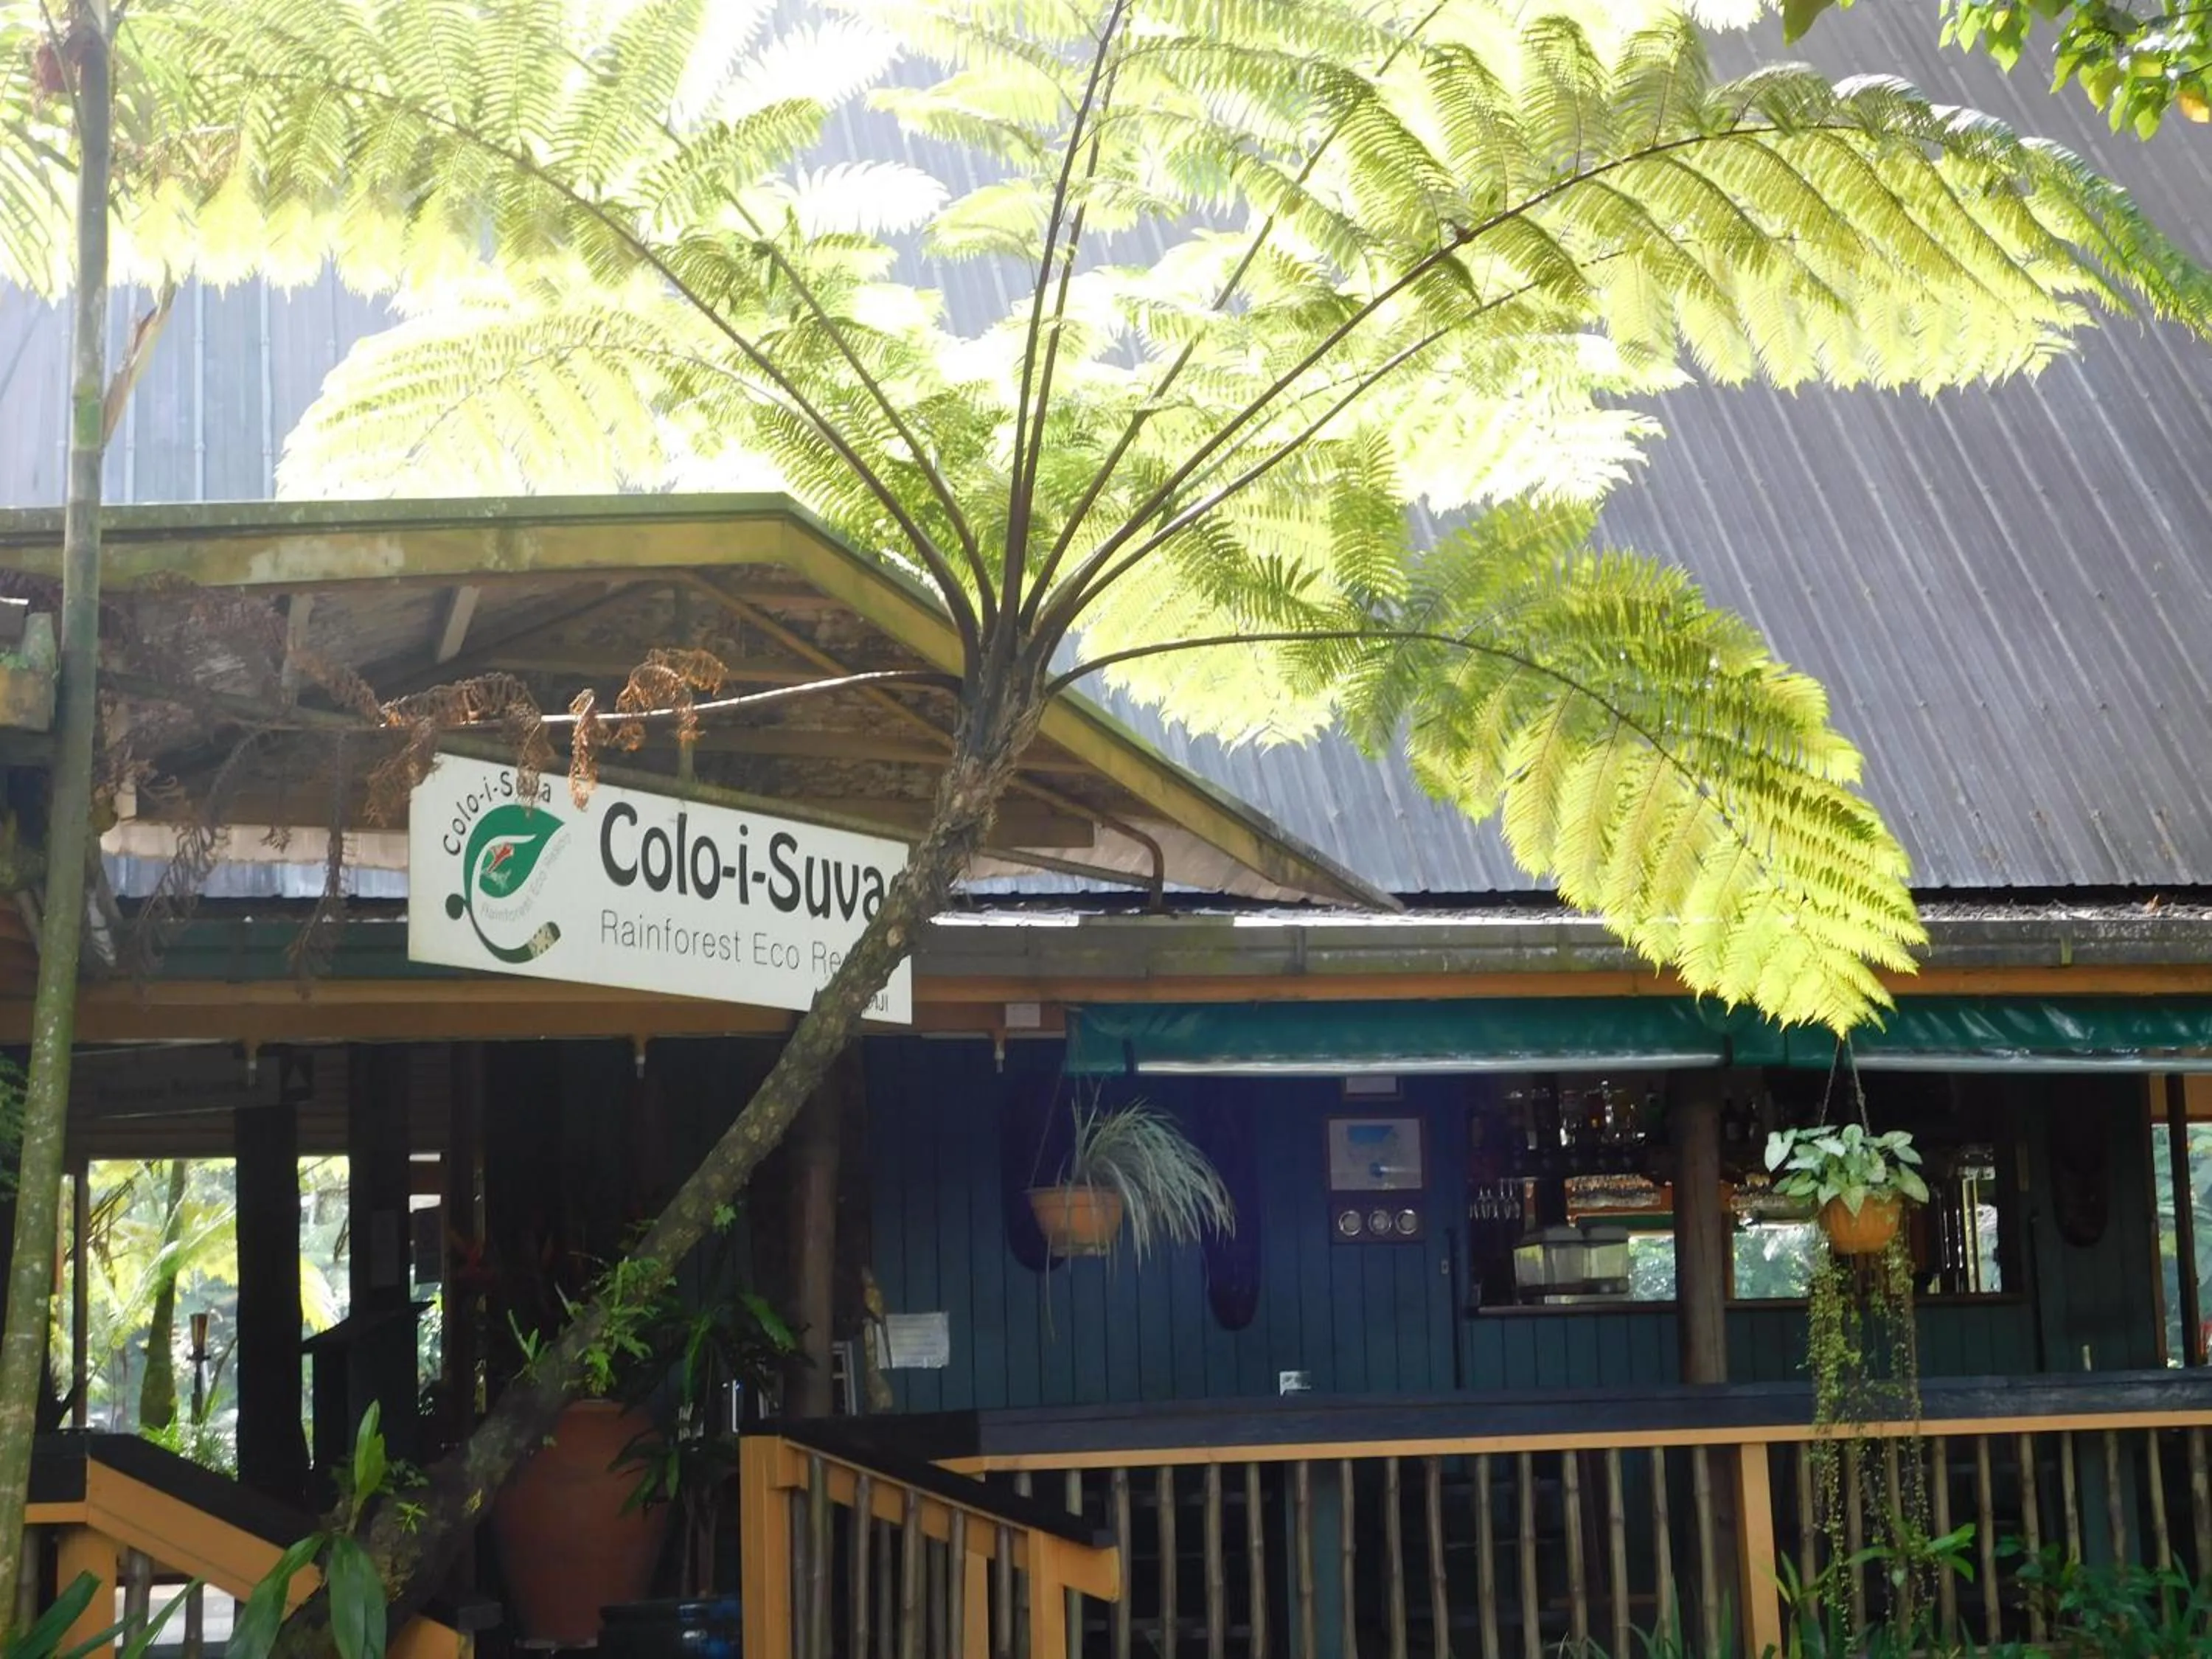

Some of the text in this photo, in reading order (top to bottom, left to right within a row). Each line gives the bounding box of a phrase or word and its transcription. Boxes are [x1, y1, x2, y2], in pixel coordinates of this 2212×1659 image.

[443, 771, 552, 855] Colo-i-Sa
[599, 801, 885, 922] Colo-i-Suva
[600, 908, 742, 964] Rainforest
[753, 932, 801, 970] Eco
